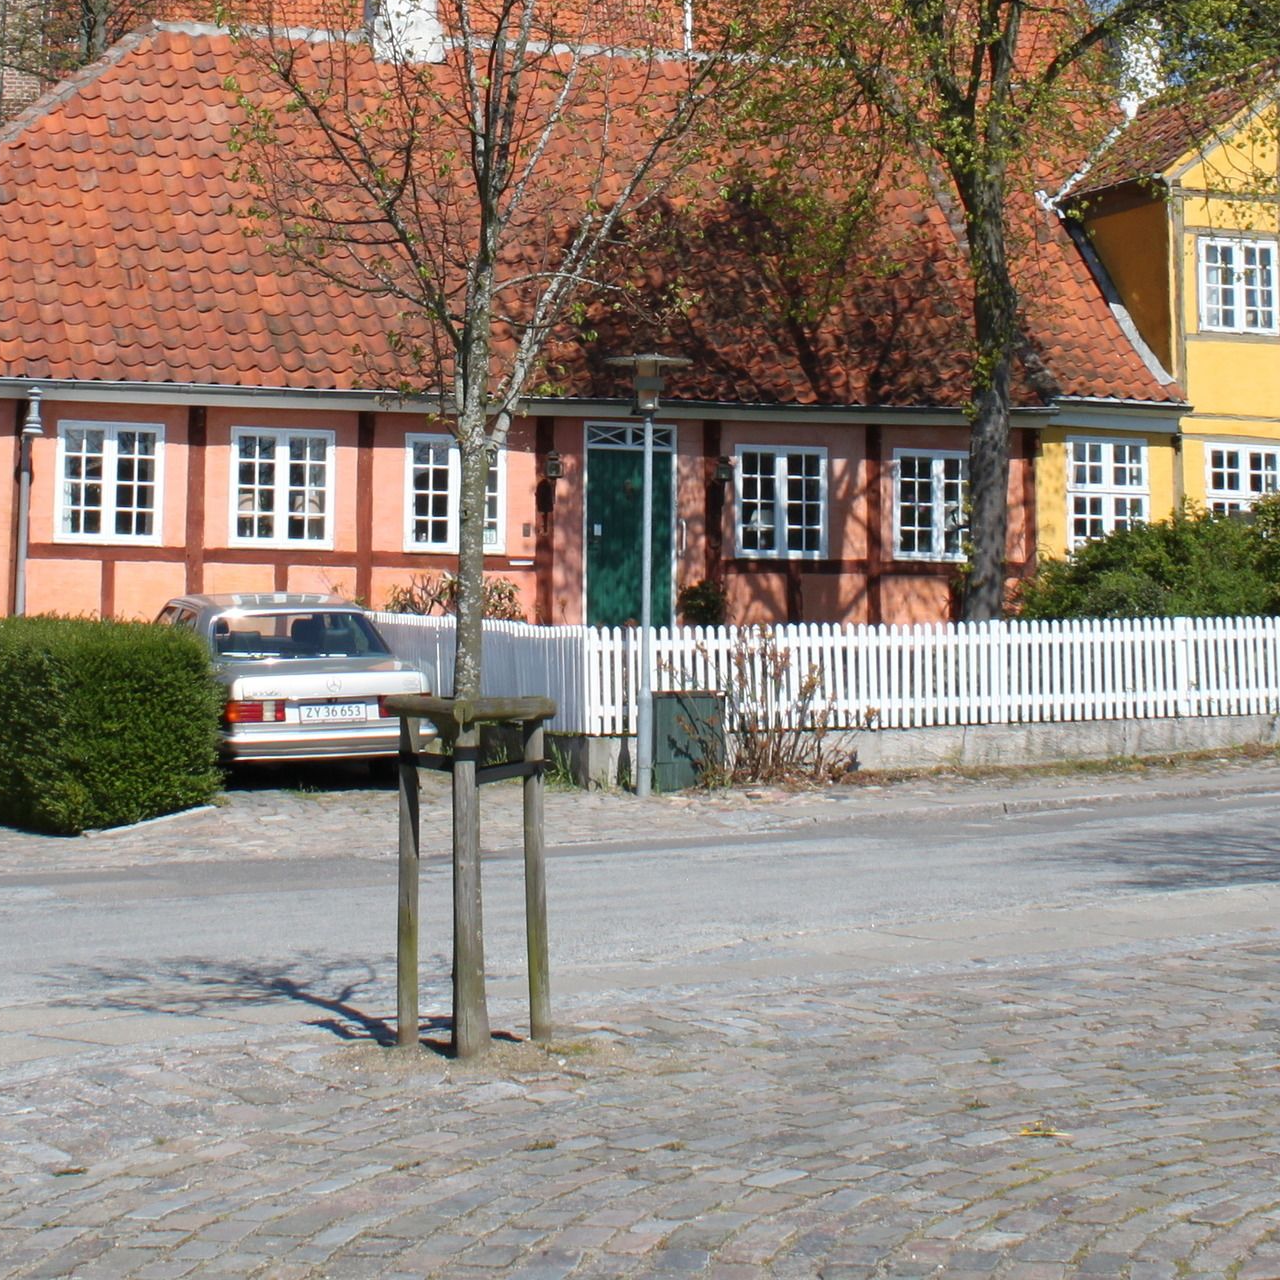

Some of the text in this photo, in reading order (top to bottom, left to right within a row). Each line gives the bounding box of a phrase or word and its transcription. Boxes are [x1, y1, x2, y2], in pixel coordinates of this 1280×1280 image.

[306, 705, 361, 718] ZY 36 653
